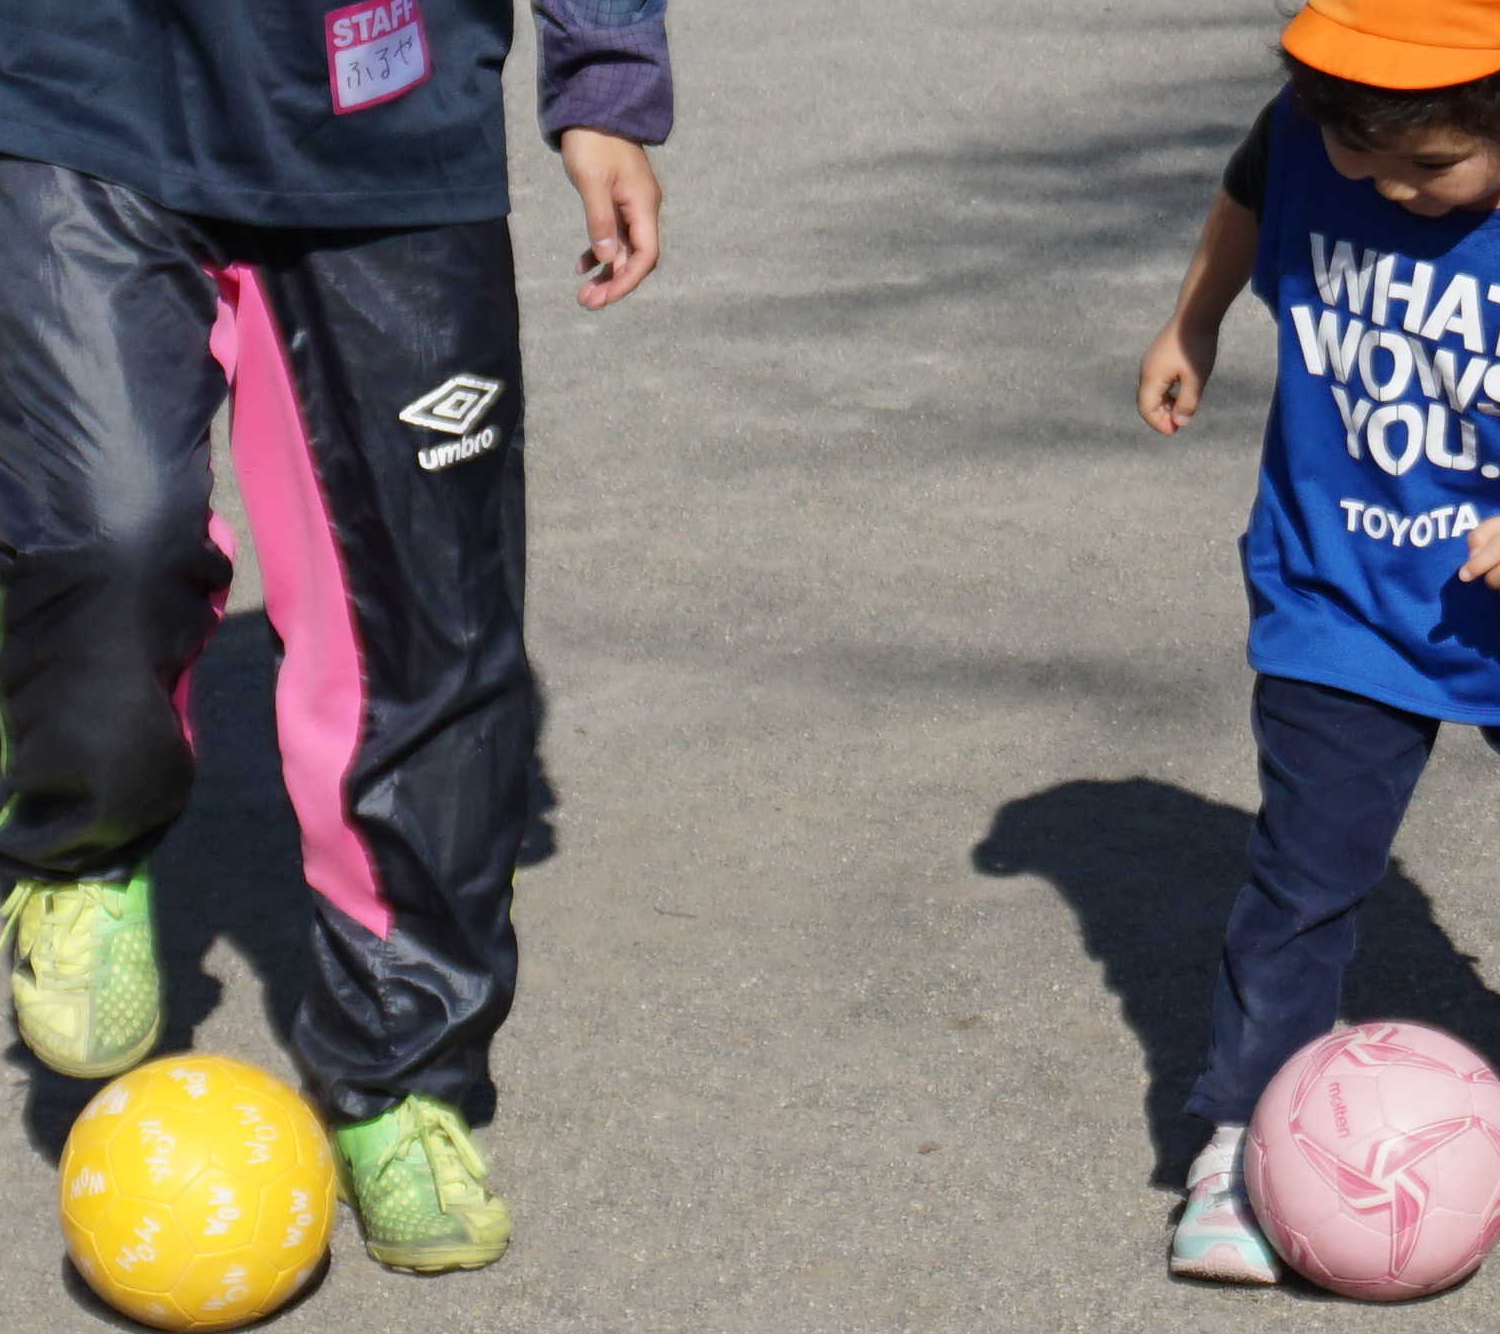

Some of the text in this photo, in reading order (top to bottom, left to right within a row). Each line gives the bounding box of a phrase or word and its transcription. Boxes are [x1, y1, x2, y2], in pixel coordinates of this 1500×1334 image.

[417, 427, 495, 471] umbro
[1331, 384, 1500, 479] YOU.
[1340, 497, 1480, 548] TOYOTA
[1328, 1081, 1351, 1139] molten
